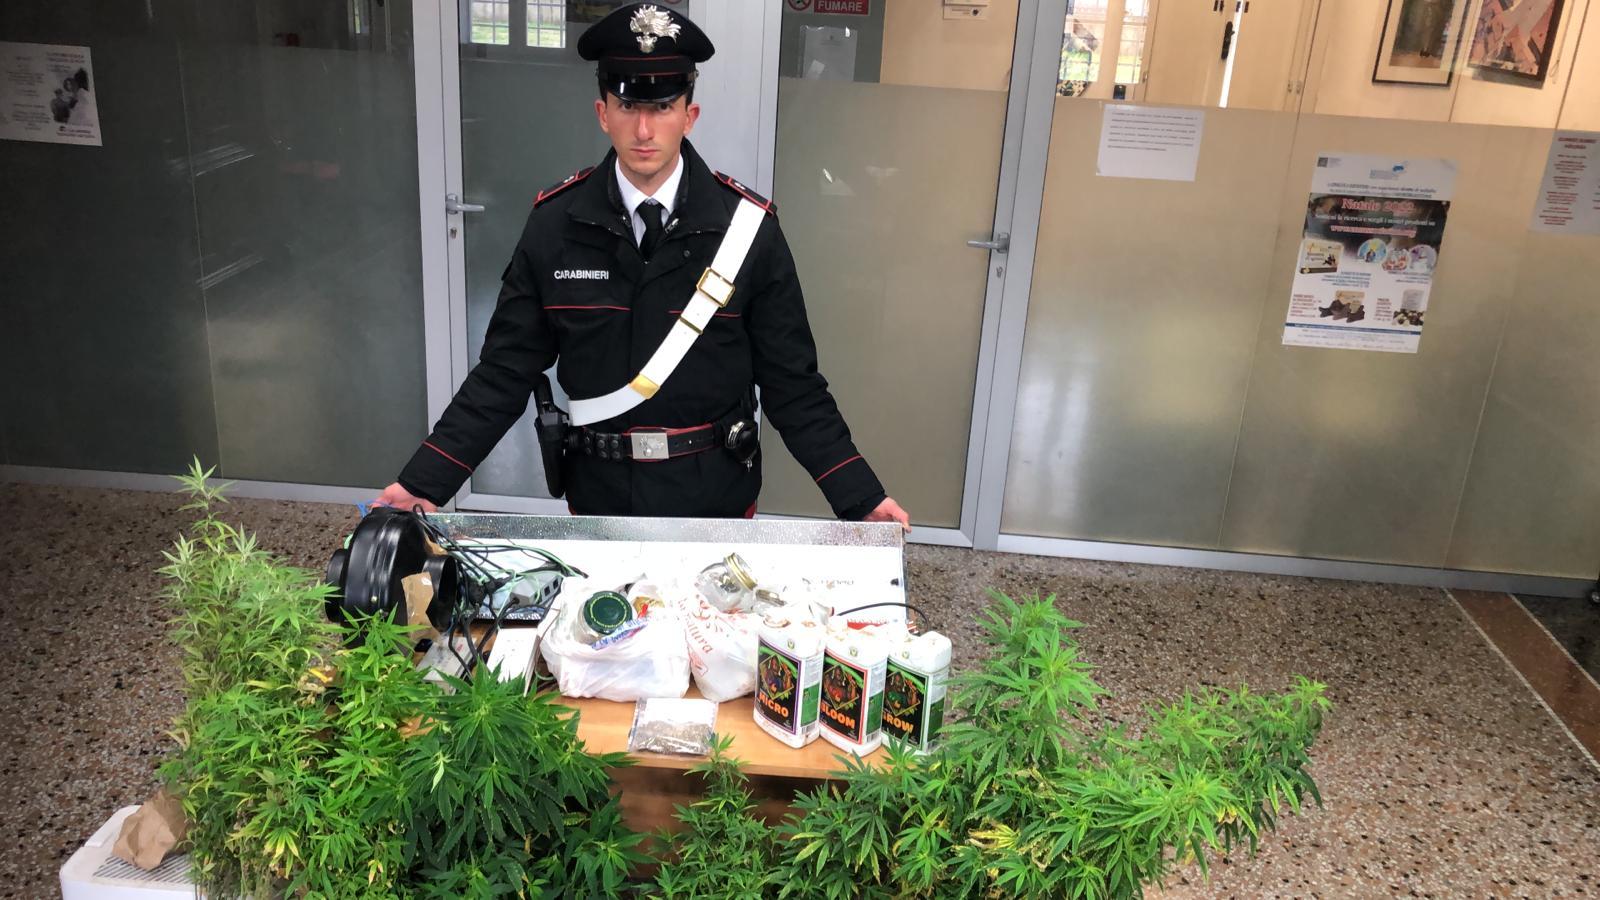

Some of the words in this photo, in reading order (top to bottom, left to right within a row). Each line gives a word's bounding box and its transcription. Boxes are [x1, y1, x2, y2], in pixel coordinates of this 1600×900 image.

[817, 0, 863, 12] FUMARE
[553, 269, 610, 280] CARABINIERI
[758, 690, 789, 718] MICRO
